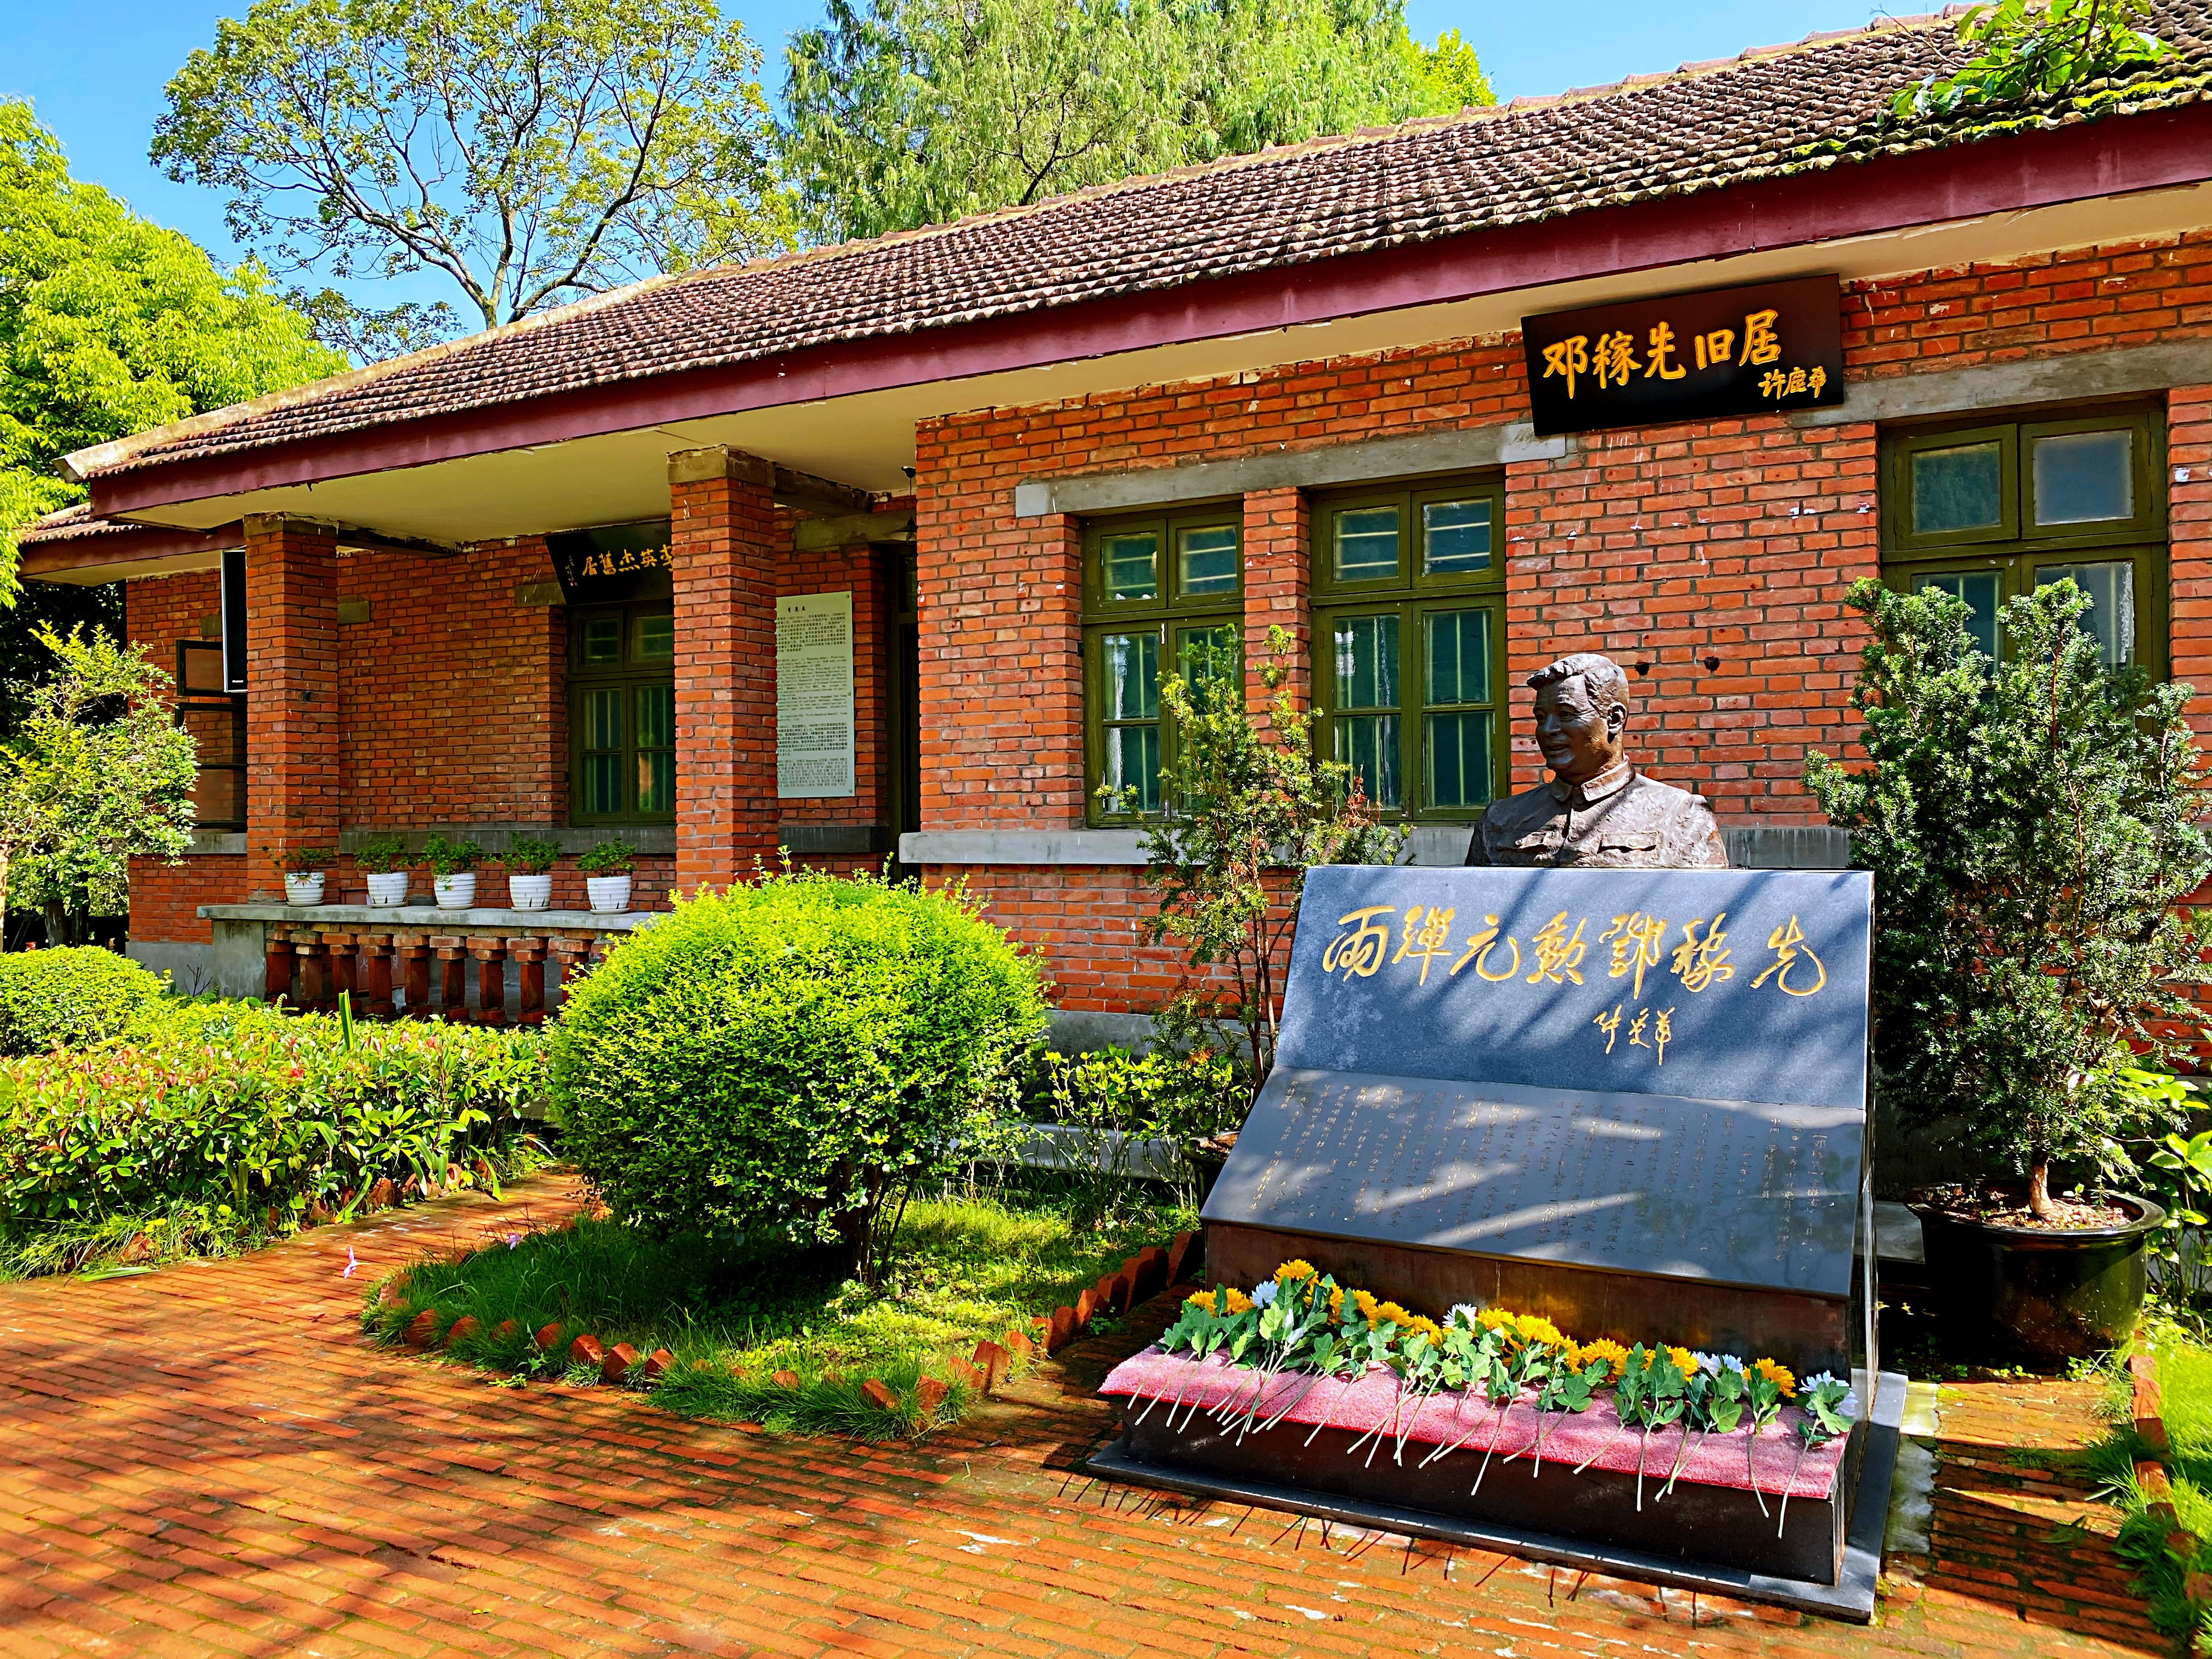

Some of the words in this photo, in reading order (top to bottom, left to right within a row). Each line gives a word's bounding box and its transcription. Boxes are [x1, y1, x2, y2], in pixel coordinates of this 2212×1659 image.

[1542, 309, 1781, 399] 邓稼先旧居
[1758, 365, 1827, 400] 许鹿希
[393, 955, 398, 966] 9
